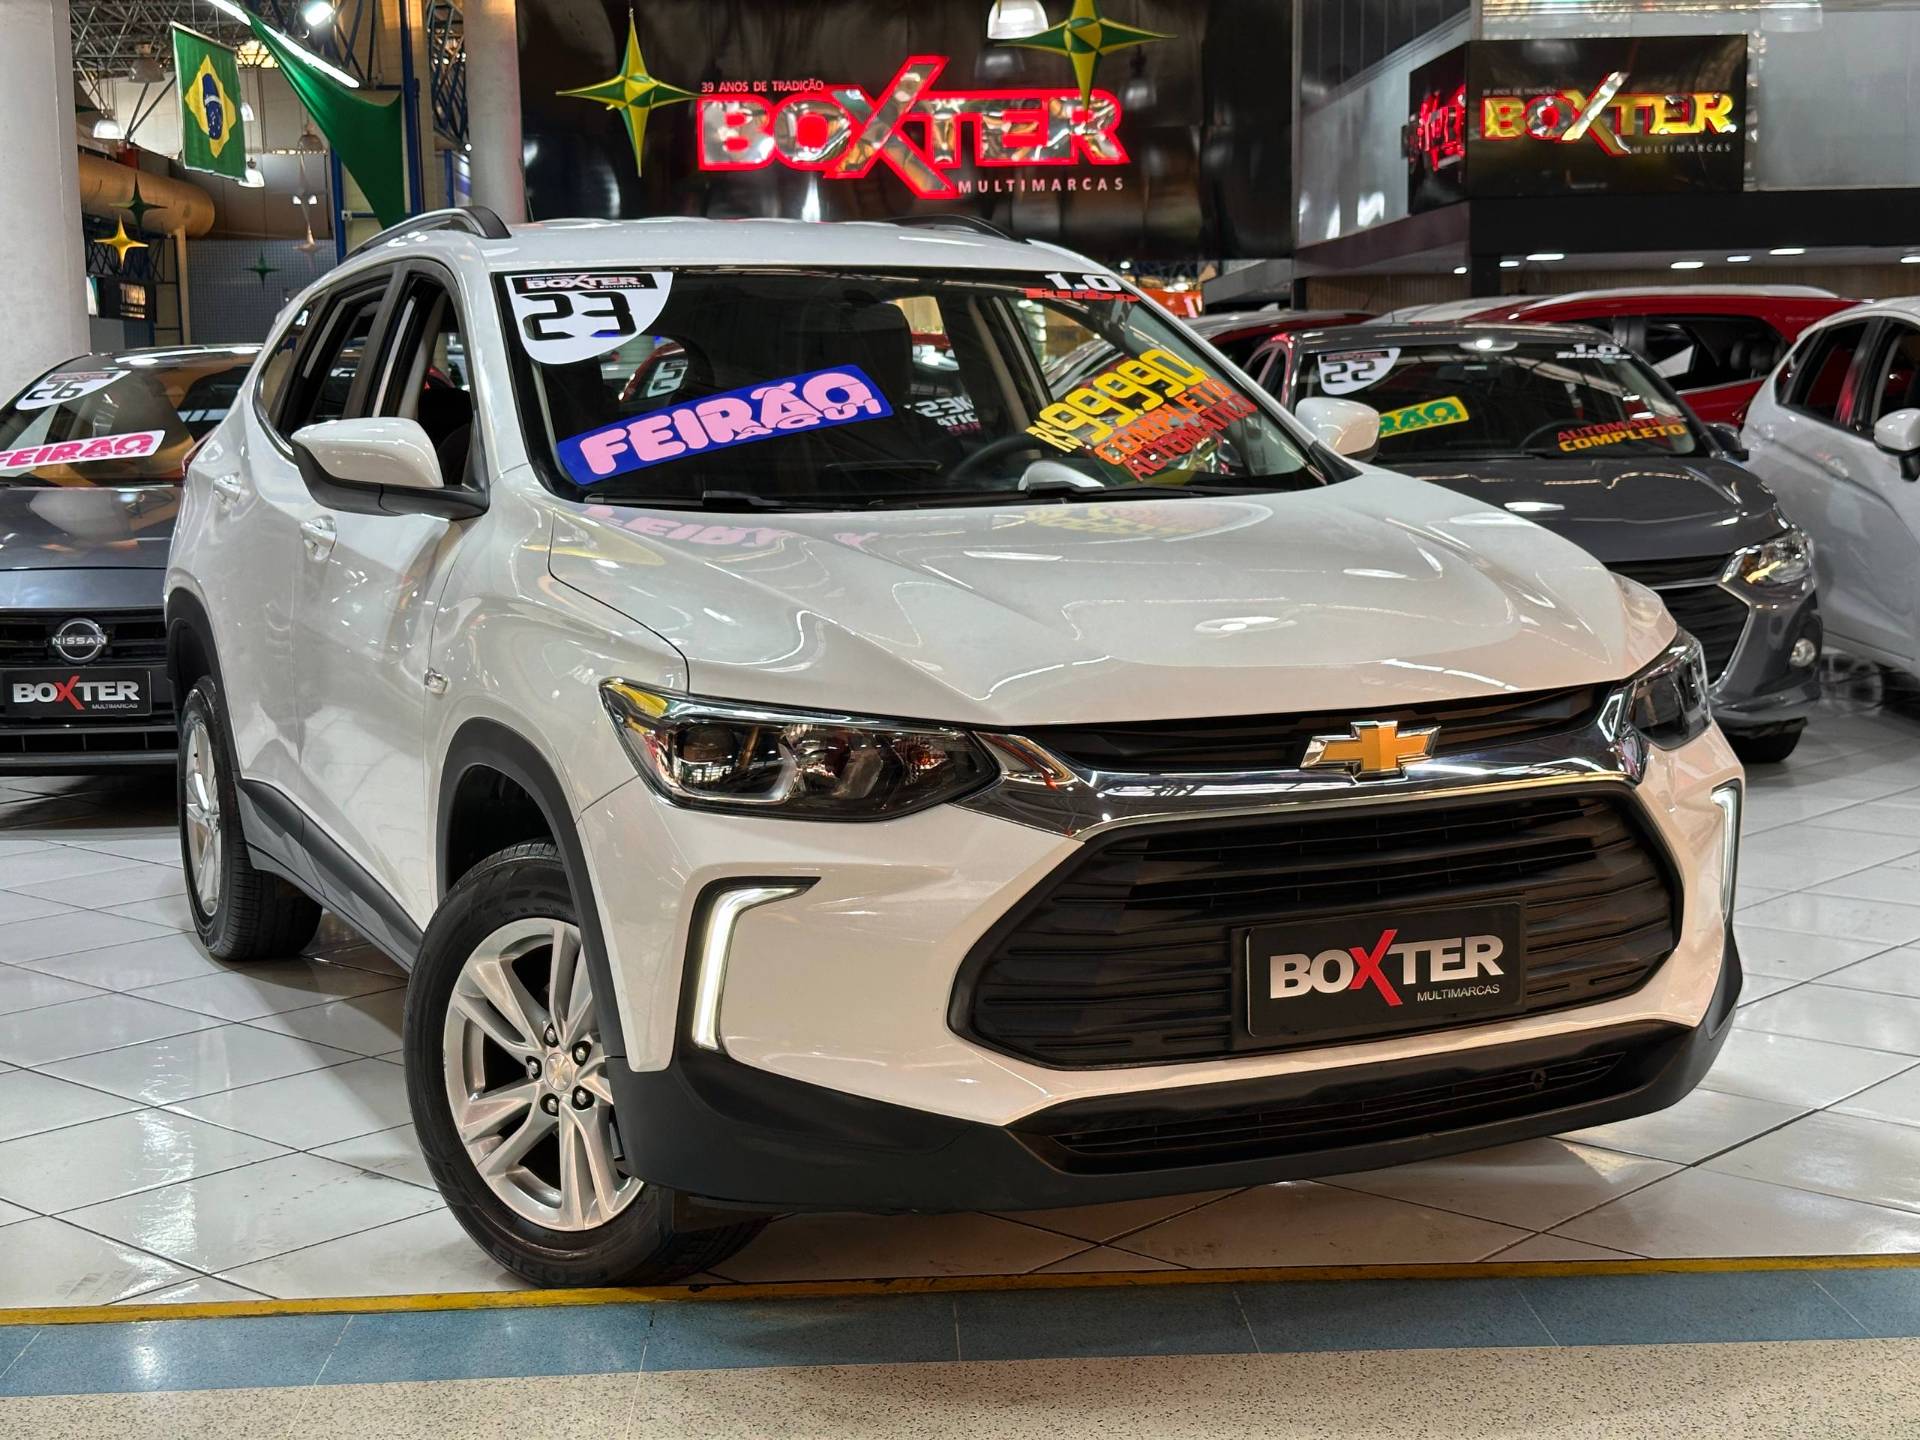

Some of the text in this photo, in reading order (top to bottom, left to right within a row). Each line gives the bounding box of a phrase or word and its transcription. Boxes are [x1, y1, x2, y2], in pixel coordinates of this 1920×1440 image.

[701, 78, 824, 93] 39 ANOS DE TRADIÇÃO
[1481, 71, 1738, 157] BOXTER
[697, 55, 1129, 199] BOXTER
[1632, 143, 1731, 154] MULTIMARCAS
[958, 177, 1124, 193] MULTIMARCAS
[525, 274, 641, 289] BOXTER
[1044, 272, 1122, 291] 1.0
[521, 291, 637, 341] 23
[1573, 343, 1620, 355] 1.0
[1324, 360, 1376, 384] 22
[579, 372, 873, 475] FEIRÃO
[1094, 378, 1233, 466] COMPLETO
[1559, 423, 1687, 453] COMPLETO
[52, 635, 107, 645] NISSAN
[13, 675, 140, 710] BOXTER
[1270, 928, 1504, 1007] BOXTER
[1416, 983, 1500, 1002] MULTIMARCAS
